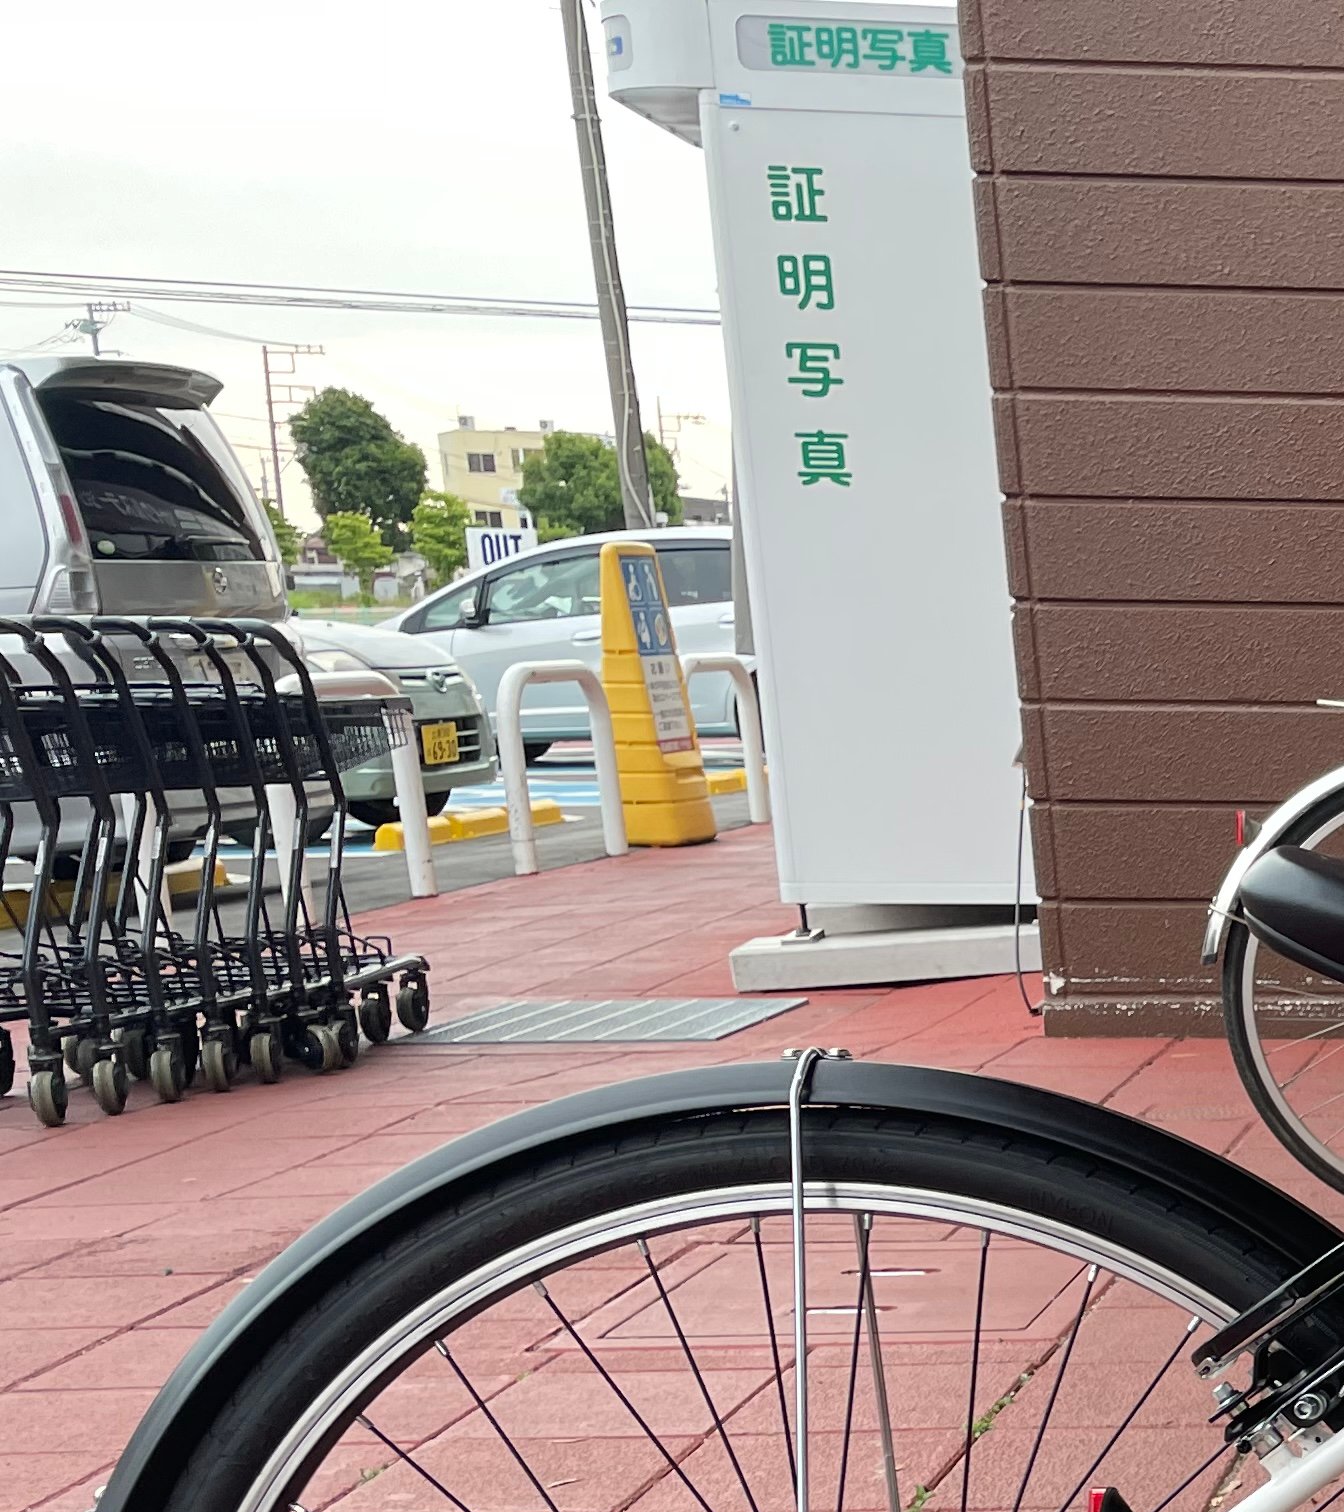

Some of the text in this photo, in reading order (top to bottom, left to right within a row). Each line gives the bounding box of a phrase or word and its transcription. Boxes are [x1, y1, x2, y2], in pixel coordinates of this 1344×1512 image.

[767, 23, 954, 75] 証明写真
[767, 164, 853, 488] 証明写真
[480, 533, 522, 566] OUT
